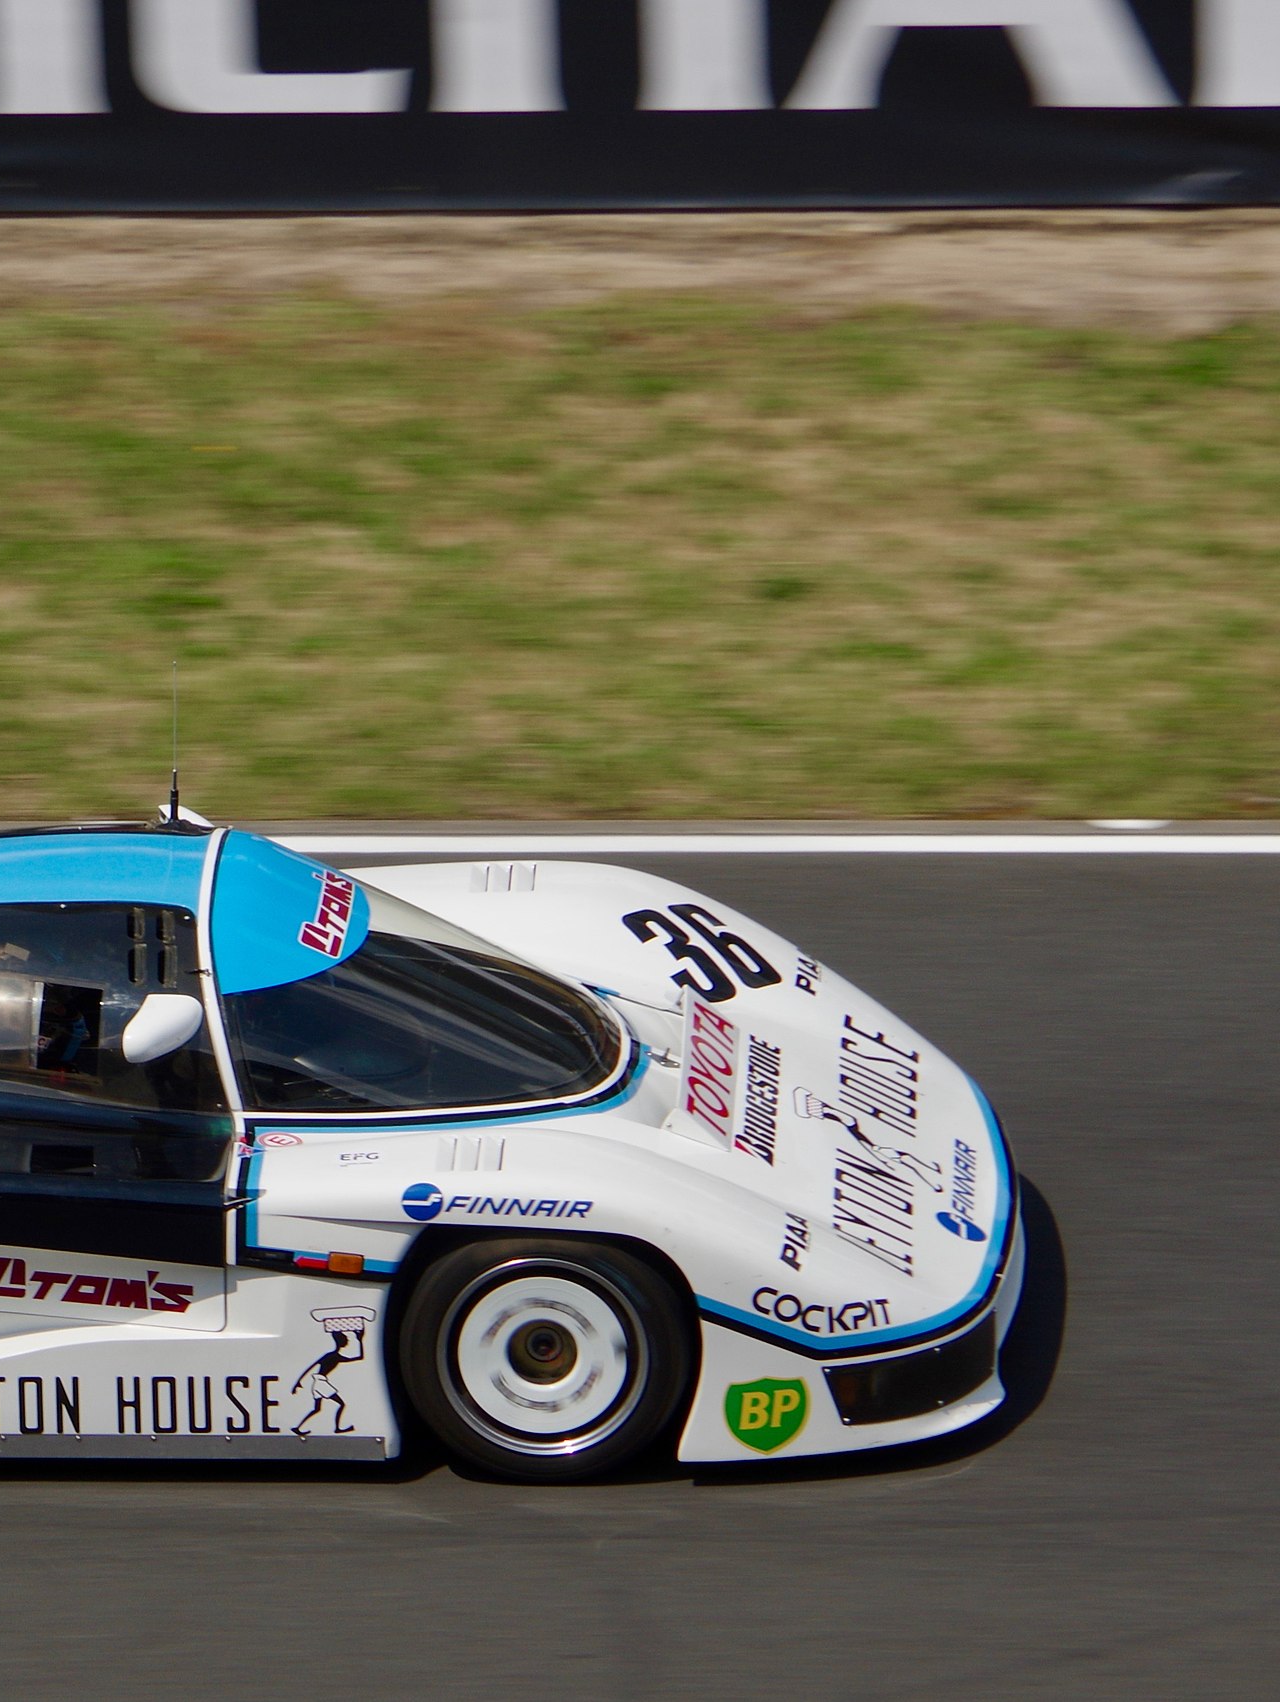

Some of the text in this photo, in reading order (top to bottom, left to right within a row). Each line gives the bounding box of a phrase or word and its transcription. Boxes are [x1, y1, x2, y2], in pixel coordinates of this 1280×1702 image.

[622, 903, 783, 1003] 36
[686, 1001, 734, 1137] TOYOTA
[734, 1034, 782, 1168] BRIDGESTONE
[832, 1014, 920, 1277] LEYTON HOUSE
[950, 1138, 977, 1222] FINNAIR
[445, 1195, 594, 1219] FINNAIR
[780, 1211, 808, 1272] PIAA
[752, 1286, 890, 1334] COCKPIT
[116, 1375, 281, 1434] HOUSE
[739, 1389, 801, 1431] BP
